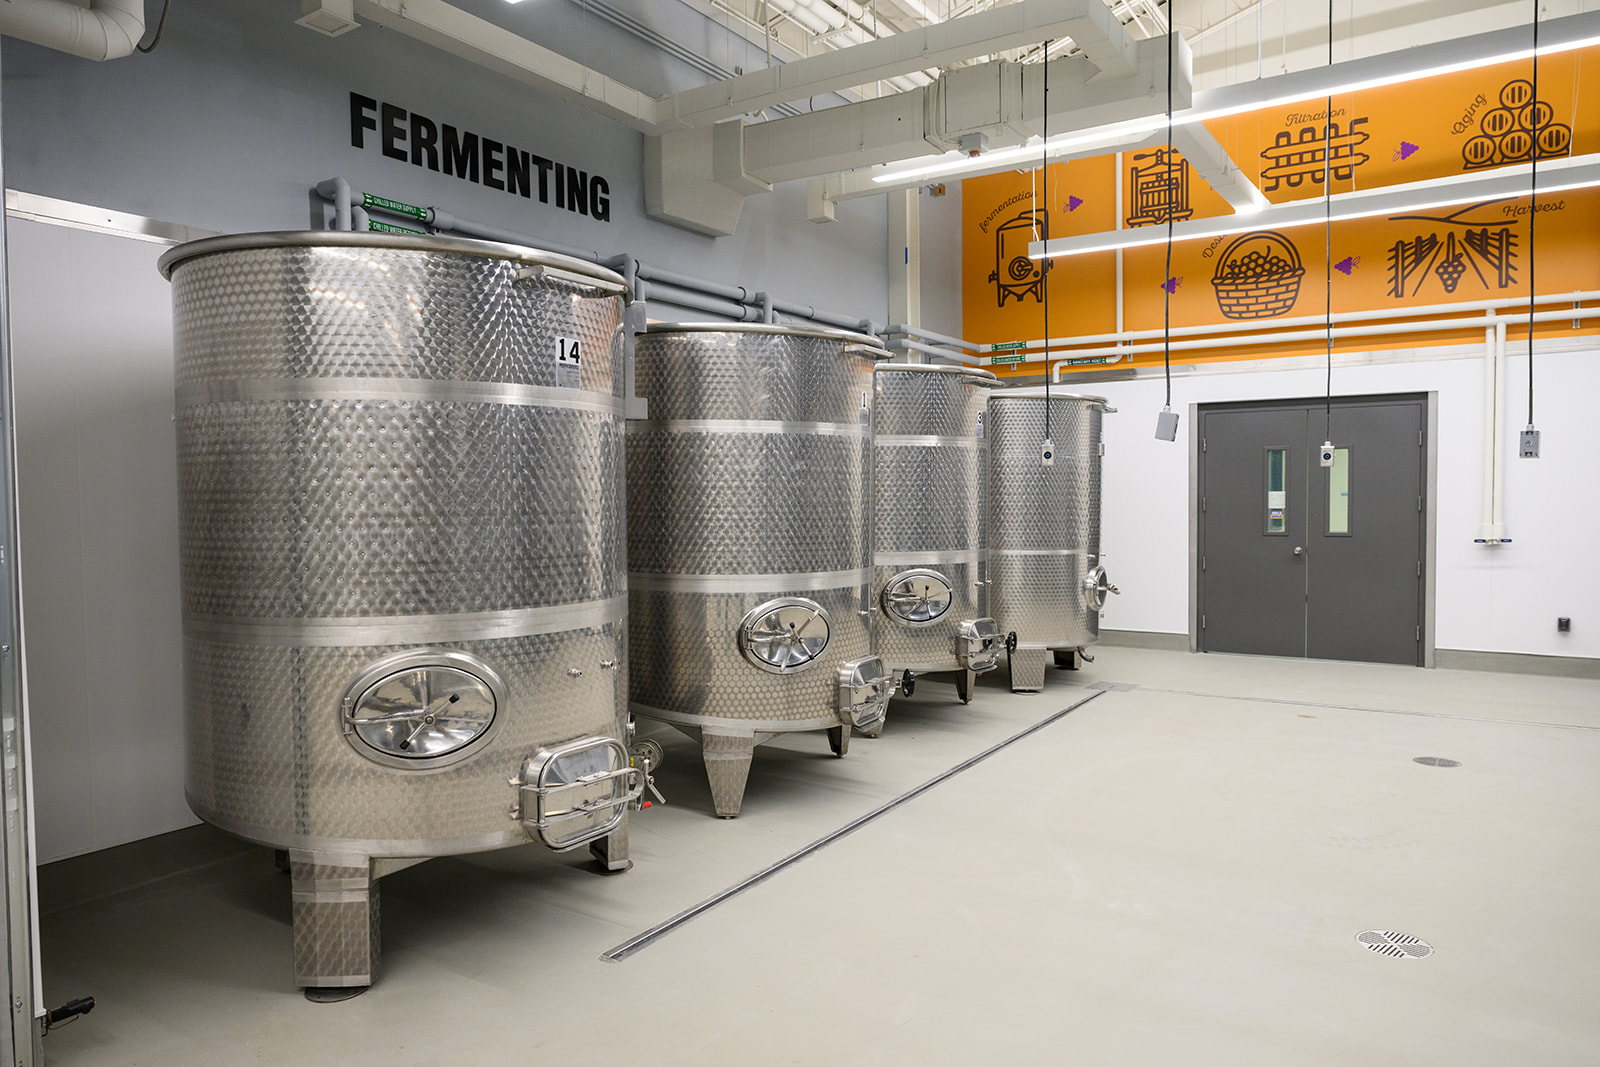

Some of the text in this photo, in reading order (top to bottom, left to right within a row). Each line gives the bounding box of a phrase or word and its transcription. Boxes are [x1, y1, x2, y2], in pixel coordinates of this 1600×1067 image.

[1451, 93, 1487, 135] Aging
[350, 91, 610, 223] FERMENTING
[559, 338, 580, 364] 14
